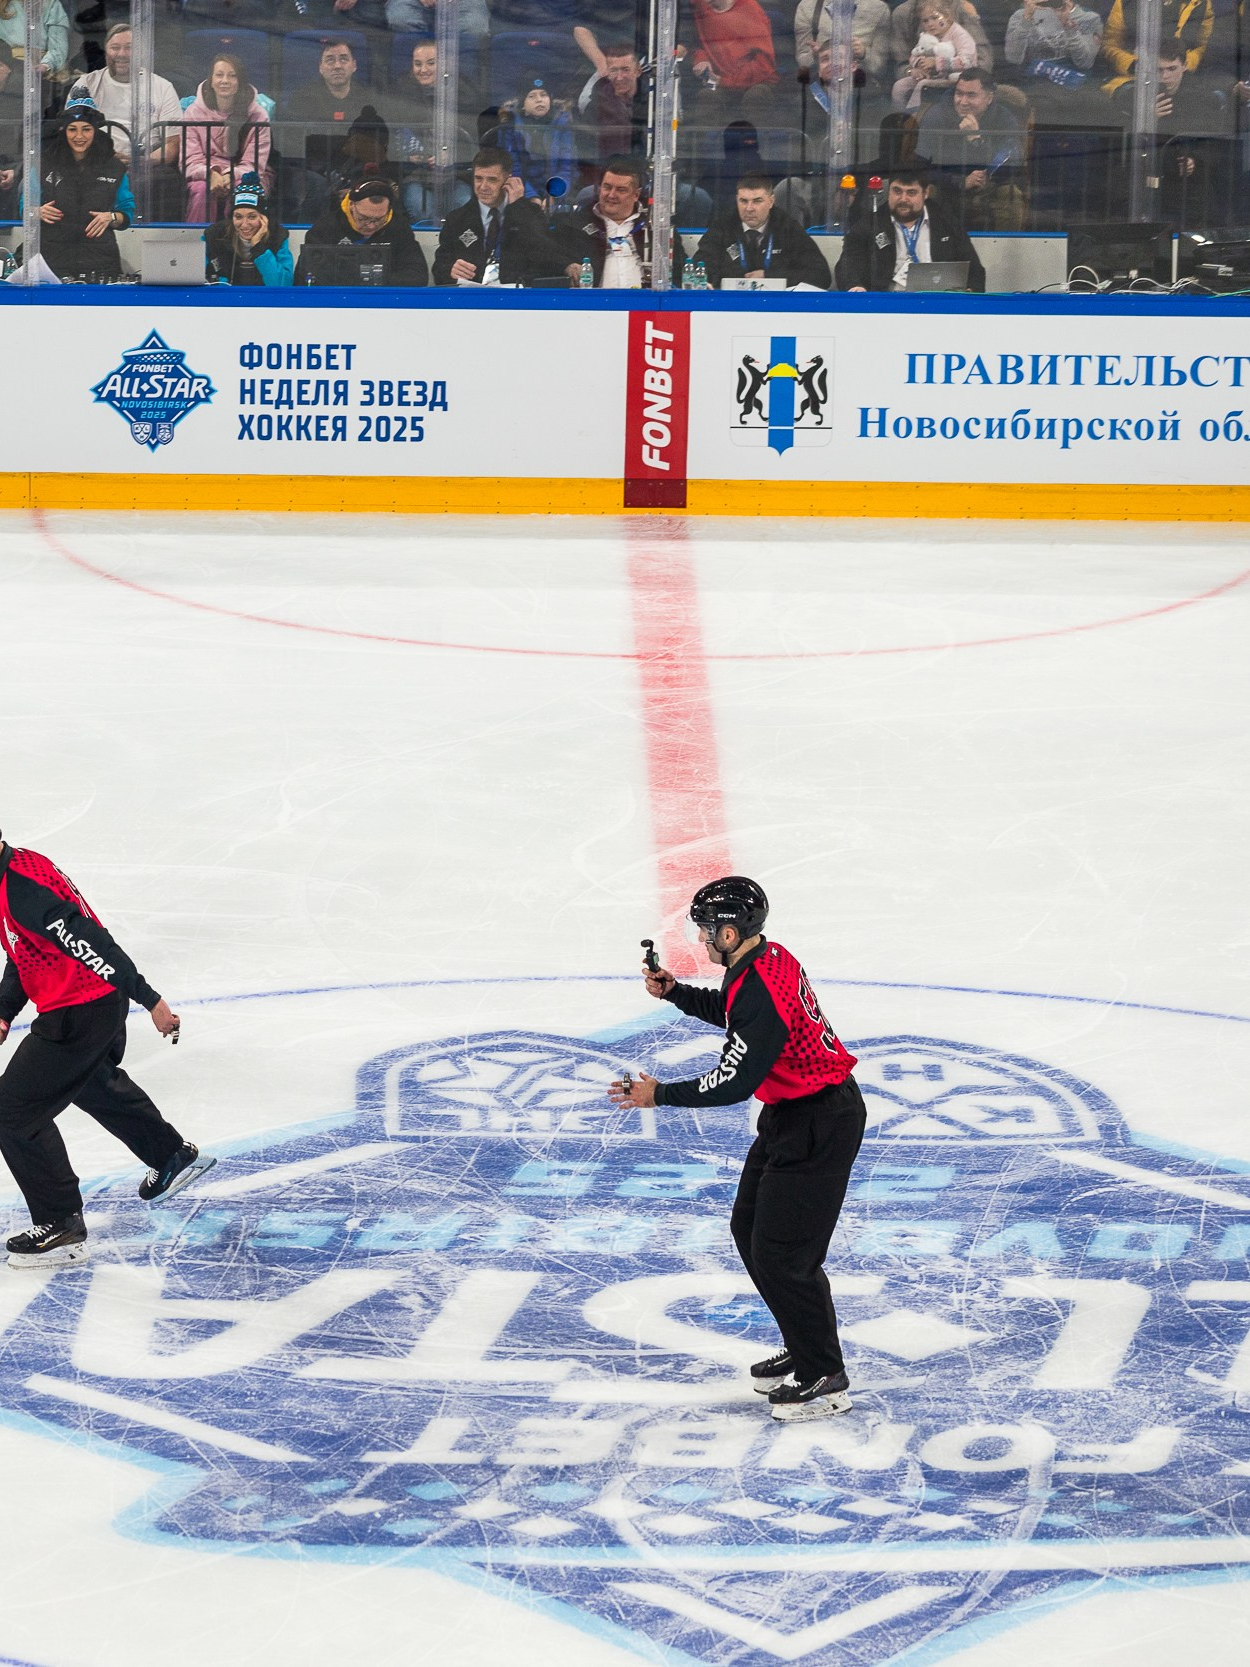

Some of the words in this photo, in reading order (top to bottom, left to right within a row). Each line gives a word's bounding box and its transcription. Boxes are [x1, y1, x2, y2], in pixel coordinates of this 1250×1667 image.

[132, 364, 175, 373] FONBET
[239, 342, 358, 371] ФОНБЕТ
[905, 353, 1250, 387] ПРАВИТЕЛЬСТ
[121, 400, 189, 409] NOVOSIBIRSK
[239, 378, 350, 410] НЕДЕЛЯ
[360, 380, 449, 412] ЗВЕЗД
[642, 321, 675, 471] FONBET
[140, 411, 167, 419] 2025
[238, 414, 347, 442] ХОККЕЯ
[357, 415, 425, 443] 2025
[857, 406, 1181, 450] Новосибирской
[1199, 409, 1250, 442] об
[360, 1417, 1185, 1477] FONBET
